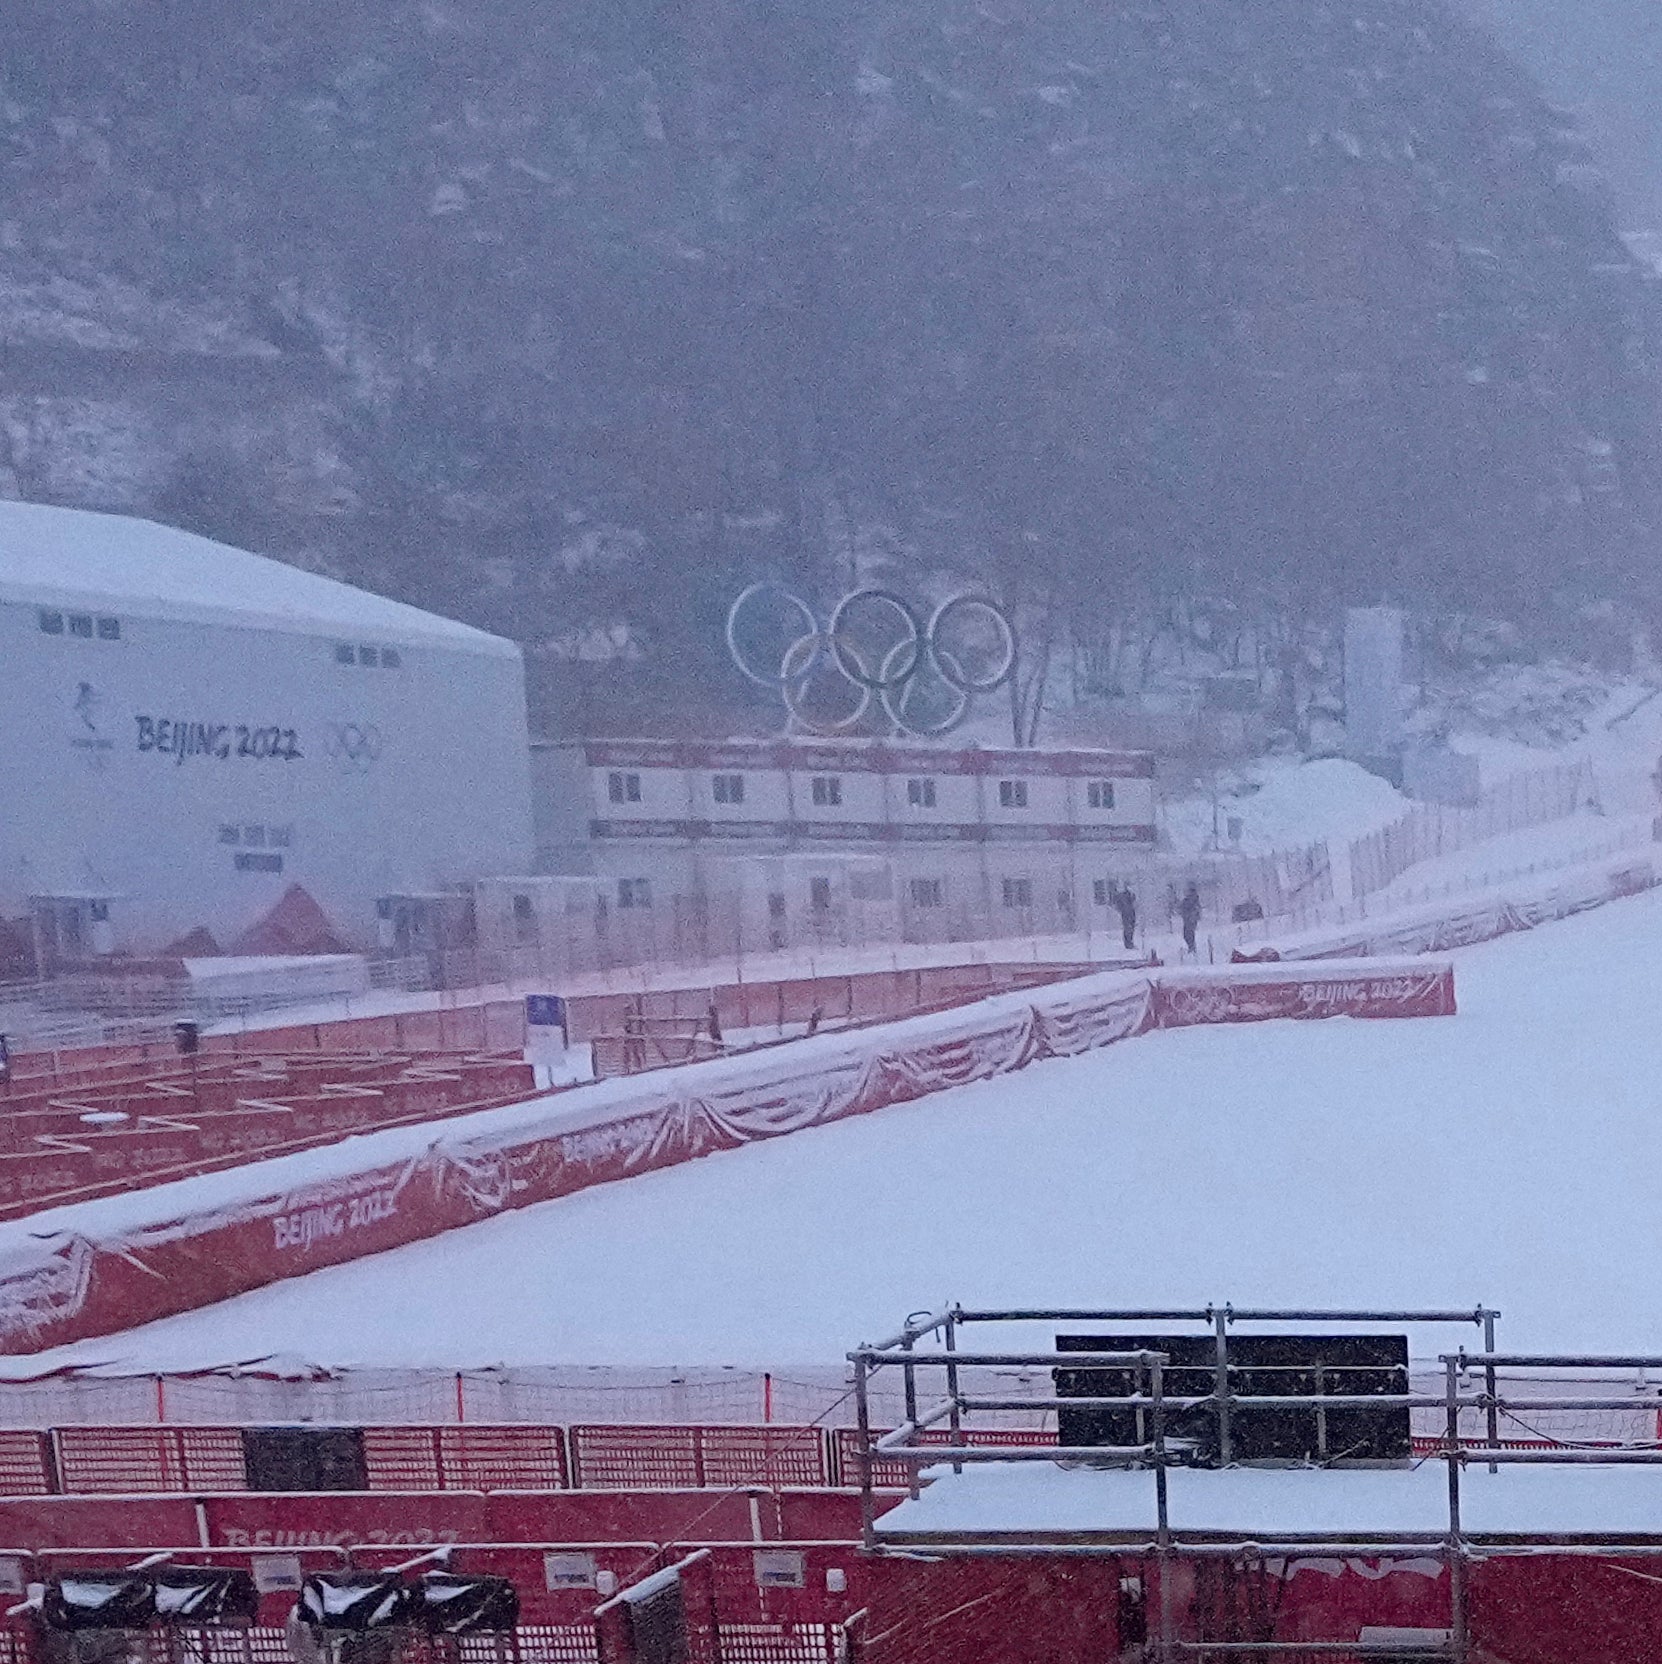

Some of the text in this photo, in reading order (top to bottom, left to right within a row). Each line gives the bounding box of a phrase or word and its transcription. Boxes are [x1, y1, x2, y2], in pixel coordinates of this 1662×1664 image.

[134, 714, 305, 765] BEIJING 2022
[274, 1203, 345, 1252] BEIJING
